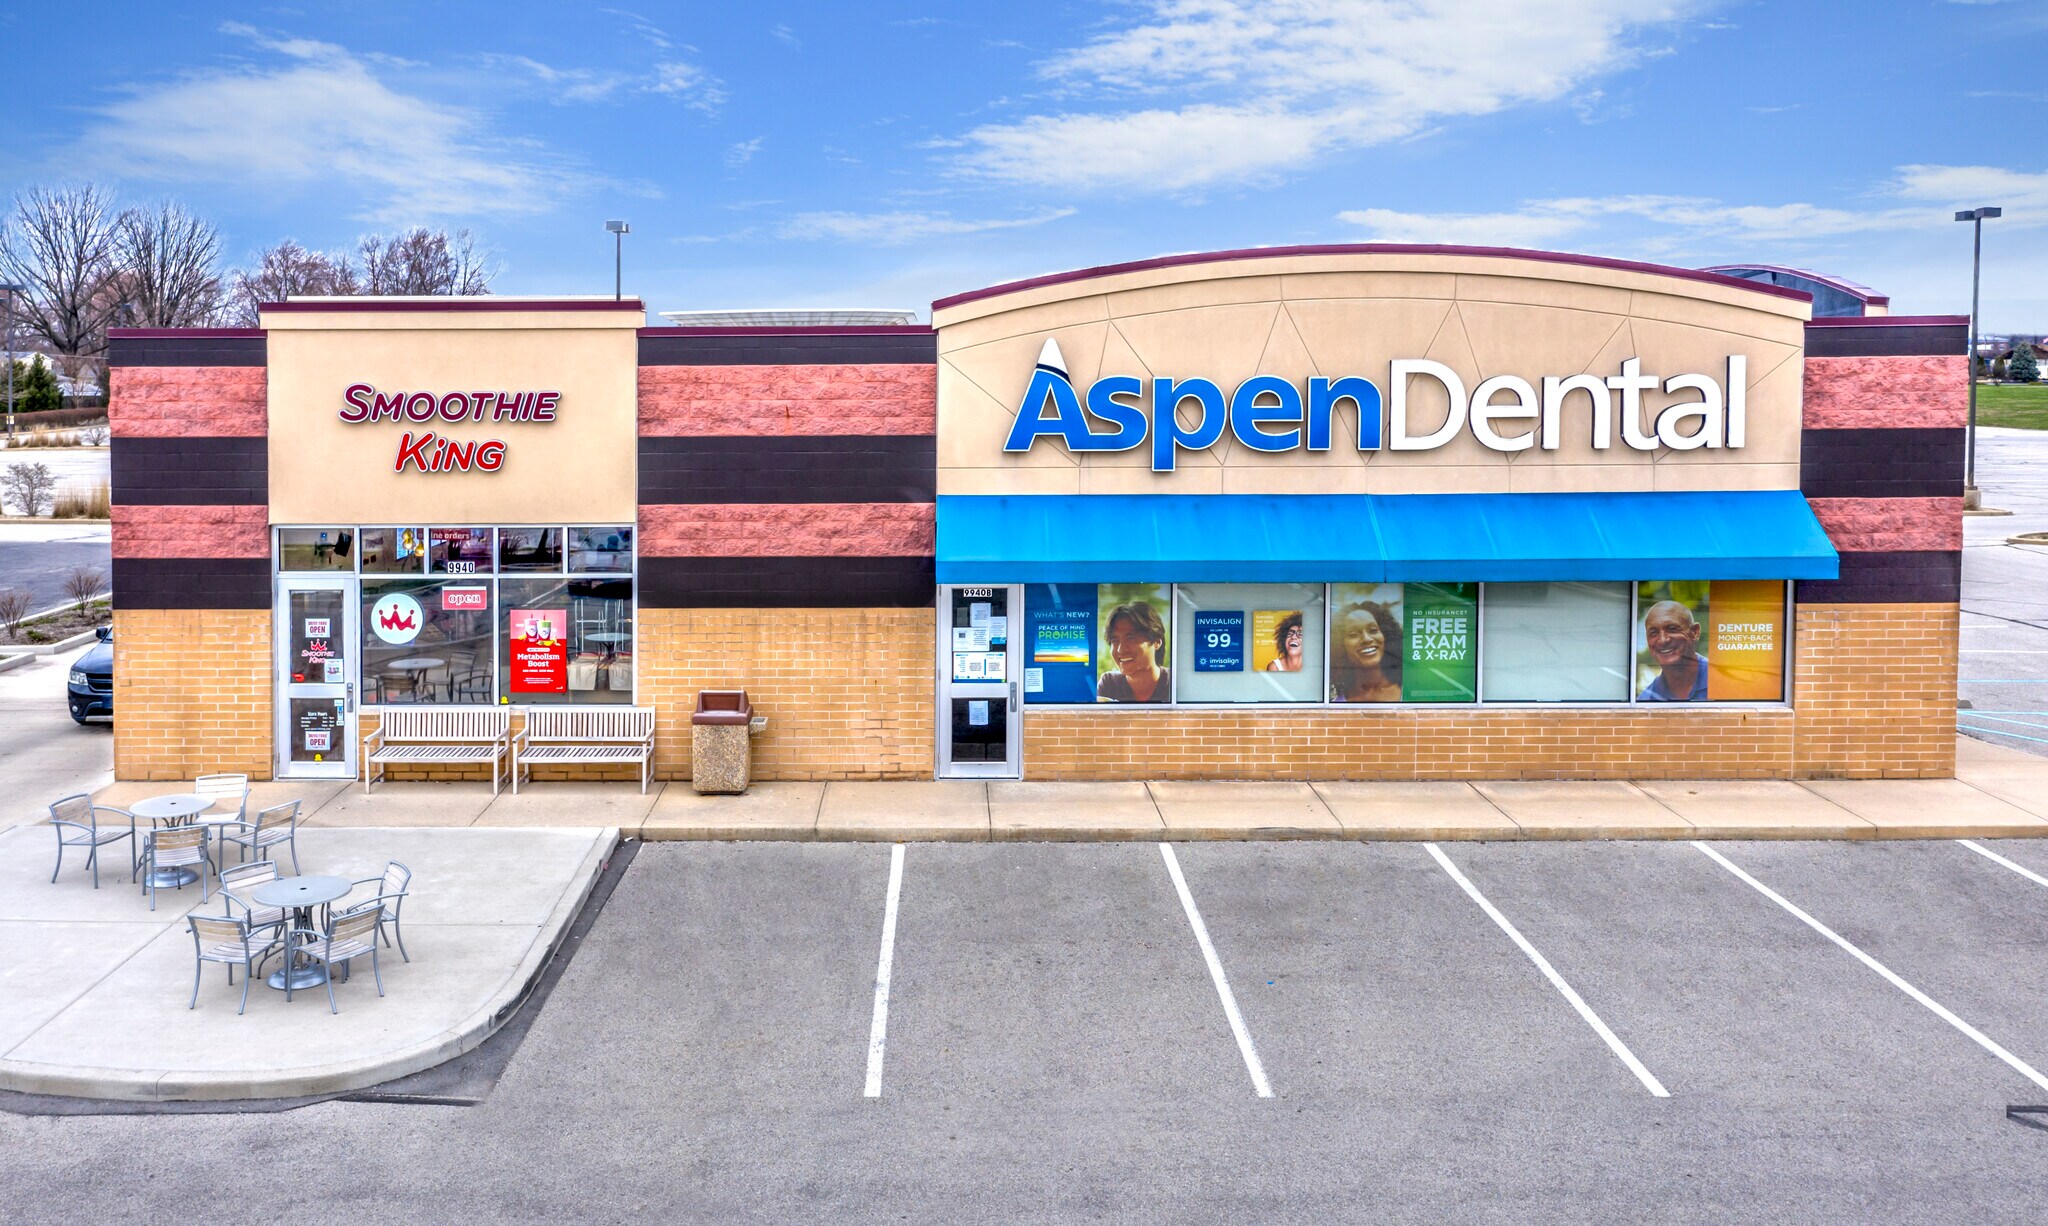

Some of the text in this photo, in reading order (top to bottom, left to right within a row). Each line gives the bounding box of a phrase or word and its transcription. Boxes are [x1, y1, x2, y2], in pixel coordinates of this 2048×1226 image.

[338, 382, 562, 423] SMOOTHIE
[444, 531, 470, 539] orders
[448, 562, 475, 573] 9940
[964, 589, 992, 597] 9940B
[448, 594, 481, 606] open
[1034, 611, 1065, 619] WHAT'S
[1412, 618, 1467, 634] FREE
[1718, 623, 1773, 632] DENTURE
[1038, 630, 1086, 640] PROMISE
[1718, 634, 1773, 642] MONEY-BACK
[1412, 635, 1467, 649] EXAM
[1717, 643, 1773, 651] GUARANTEE
[1412, 650, 1467, 660] & X-RAY
[1209, 657, 1240, 665] invisalign
[310, 738, 326, 746] OPEN
